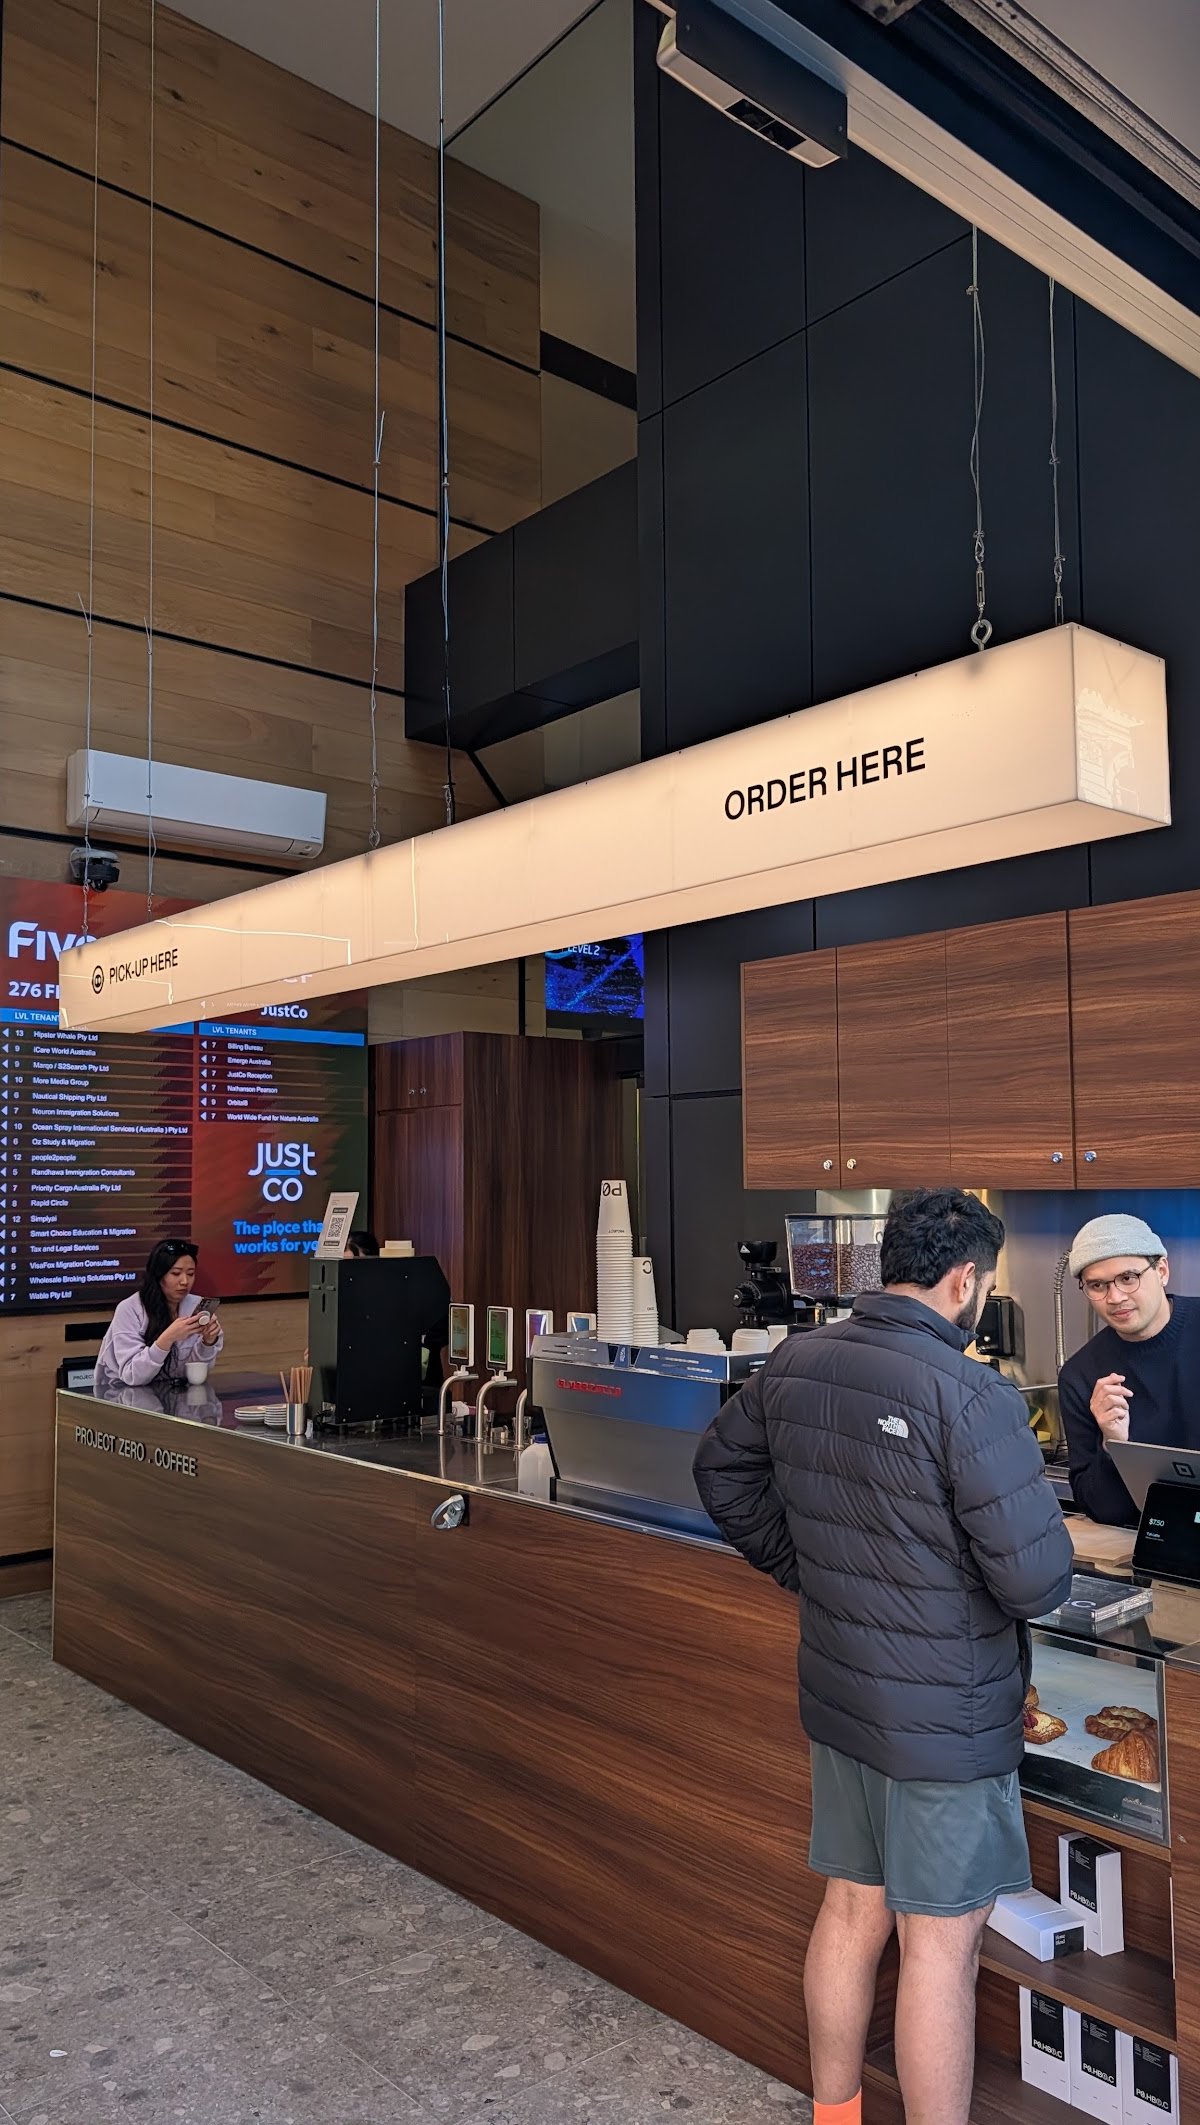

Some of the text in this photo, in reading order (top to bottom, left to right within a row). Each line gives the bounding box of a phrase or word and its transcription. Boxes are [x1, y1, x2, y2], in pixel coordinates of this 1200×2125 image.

[724, 737, 926, 820] ORDER HERE
[594, 945, 600, 956] 2
[109, 948, 178, 984] PICK-UP HERE
[8, 981, 42, 998] 276
[14, 1012, 59, 1021] LVL TENAN
[261, 1005, 308, 1018] JustCo
[33, 1031, 56, 1040] Hipster
[225, 1027, 256, 1036] TENANTS
[59, 1094, 85, 1102] Shipping
[56, 1109, 91, 1117] Immigration
[233, 1221, 260, 1235] The
[302, 1220, 324, 1233] tha
[234, 1238, 318, 1254] works for yo
[75, 1425, 116, 1453] PROJECT
[118, 1438, 145, 1462] ZERO
[155, 1448, 197, 1477] COFFEE
